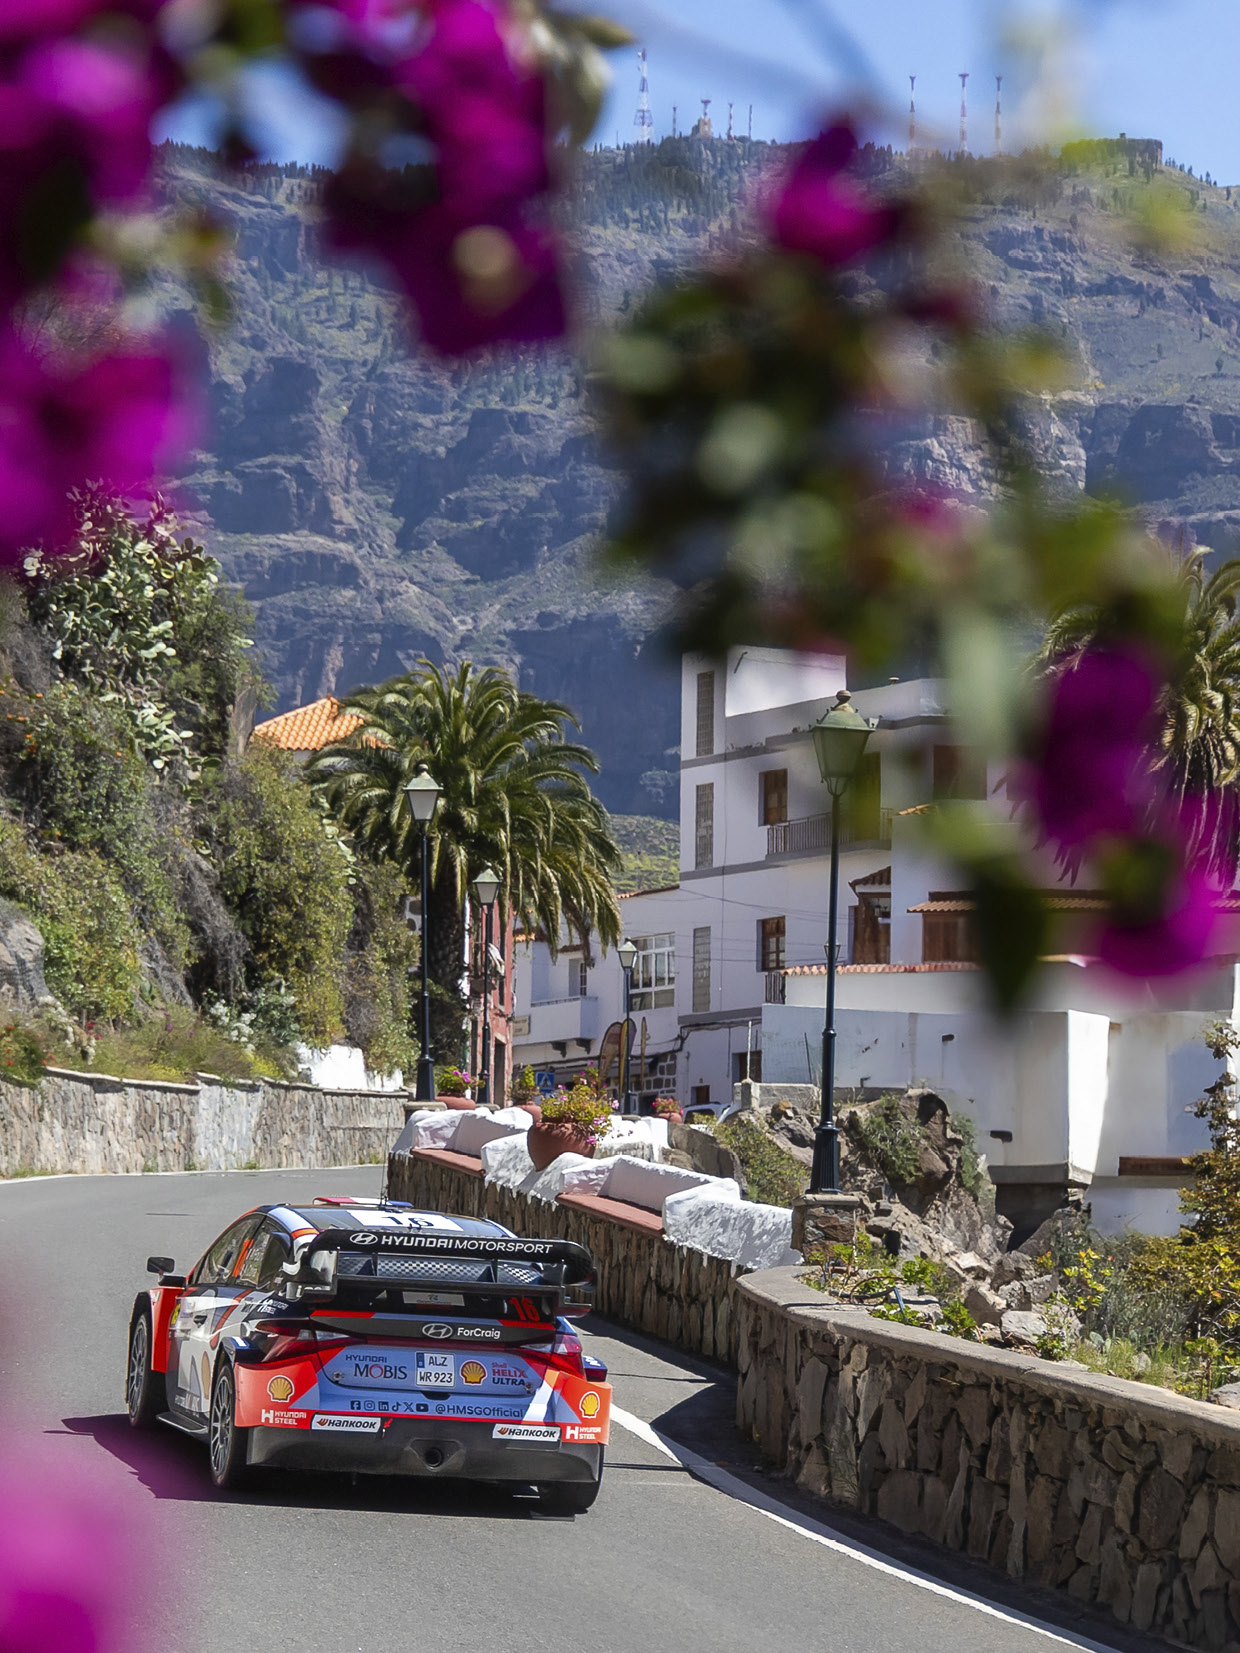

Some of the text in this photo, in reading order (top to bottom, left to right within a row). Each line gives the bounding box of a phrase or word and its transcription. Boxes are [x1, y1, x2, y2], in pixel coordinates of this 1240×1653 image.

[381, 1235, 553, 1254] HYUNDAI MOTORSPORT
[510, 1298, 540, 1322] 16
[457, 1327, 501, 1339] ForCraig
[345, 1354, 387, 1363] HYUNDAI
[428, 1356, 448, 1367] ALZ
[354, 1363, 408, 1380] MOBIS
[492, 1368, 528, 1379] HELIX
[419, 1371, 453, 1384] WR 923
[492, 1377, 526, 1386] ULTRA
[274, 1411, 307, 1419] HYUNDAI
[435, 1404, 524, 1418] @HMSGOfficial
[274, 1417, 298, 1426] STEEL
